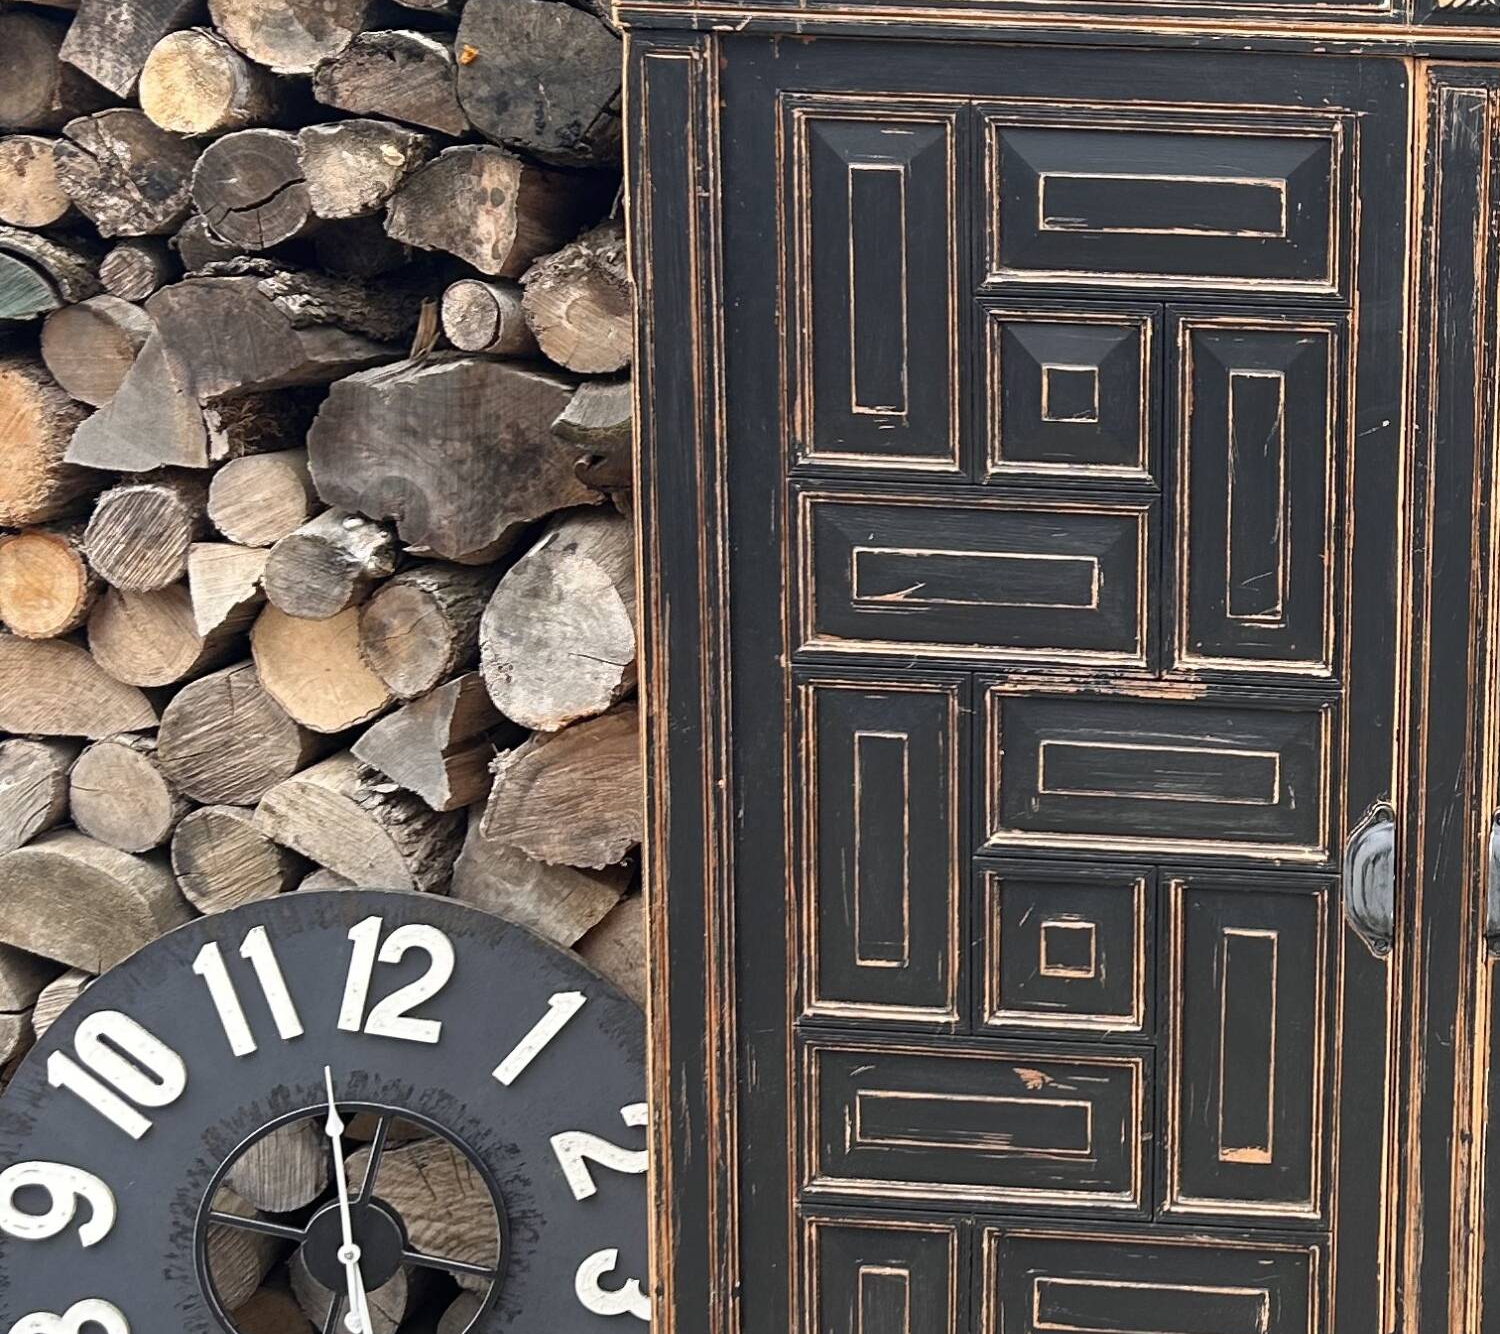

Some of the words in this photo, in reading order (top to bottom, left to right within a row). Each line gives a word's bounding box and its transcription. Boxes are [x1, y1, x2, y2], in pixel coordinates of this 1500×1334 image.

[193, 925, 304, 1057] 11
[337, 916, 456, 1044] 12
[47, 1010, 188, 1140] 10
[492, 990, 588, 1087] 1
[550, 1102, 649, 1200] 2
[0, 1160, 118, 1248] 9
[575, 1248, 652, 1321] 3
